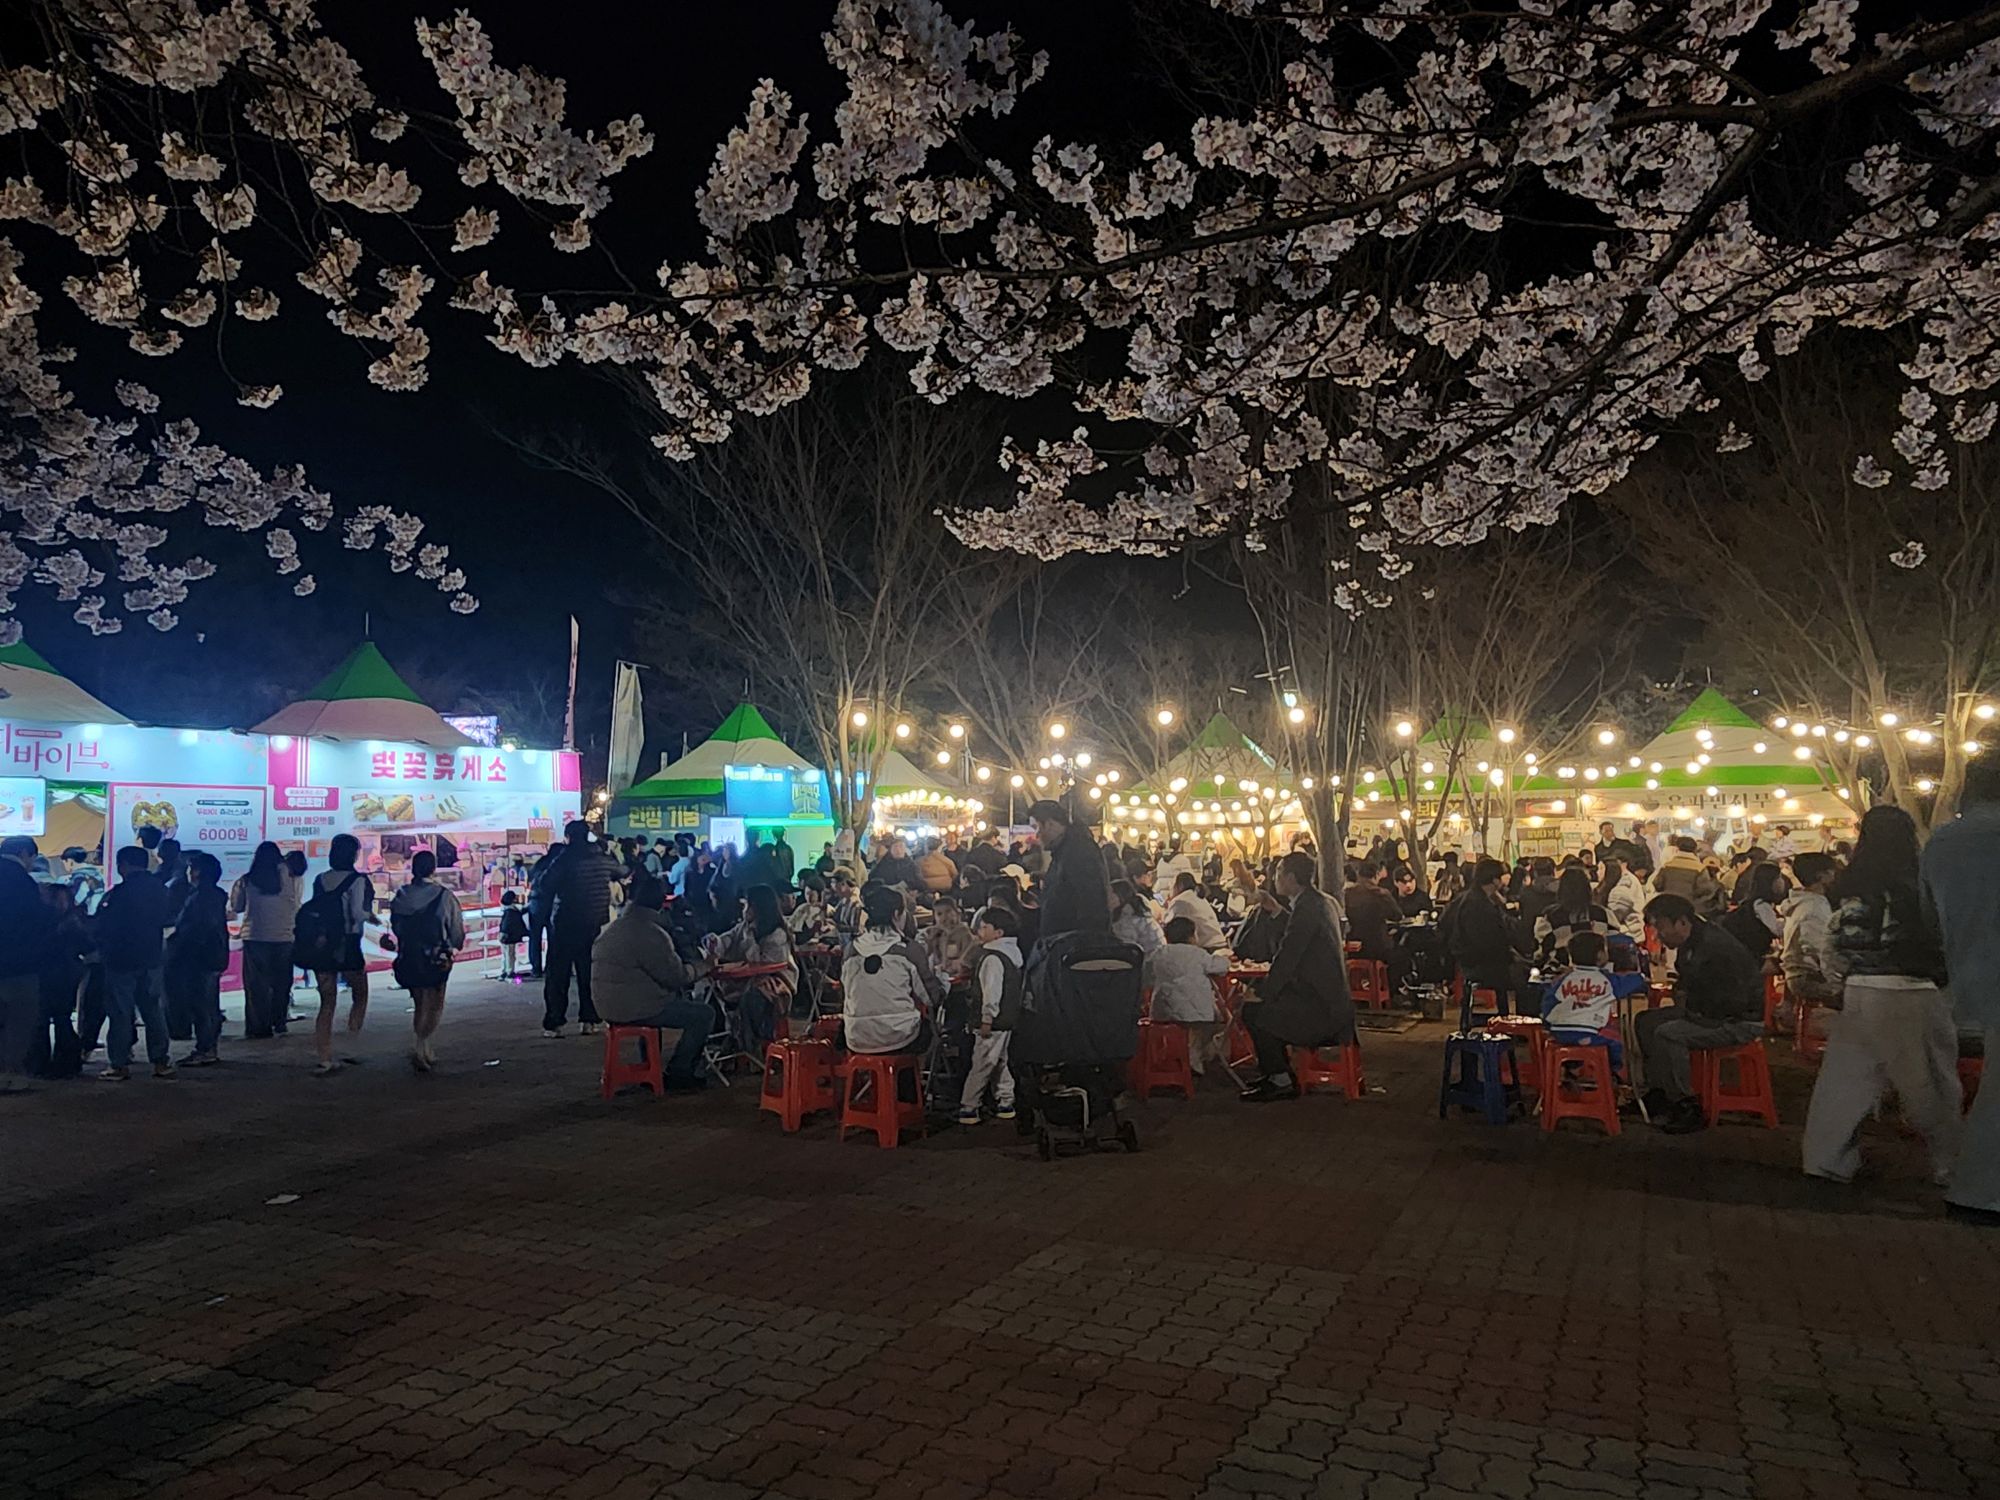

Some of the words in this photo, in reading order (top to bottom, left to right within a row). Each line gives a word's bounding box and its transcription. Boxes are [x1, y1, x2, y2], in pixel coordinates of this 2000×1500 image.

[14, 741, 109, 772] 바이브
[371, 751, 507, 781] 벚꽃휴게소
[667, 804, 699, 828] 기념
[199, 827, 248, 841] 6000원
